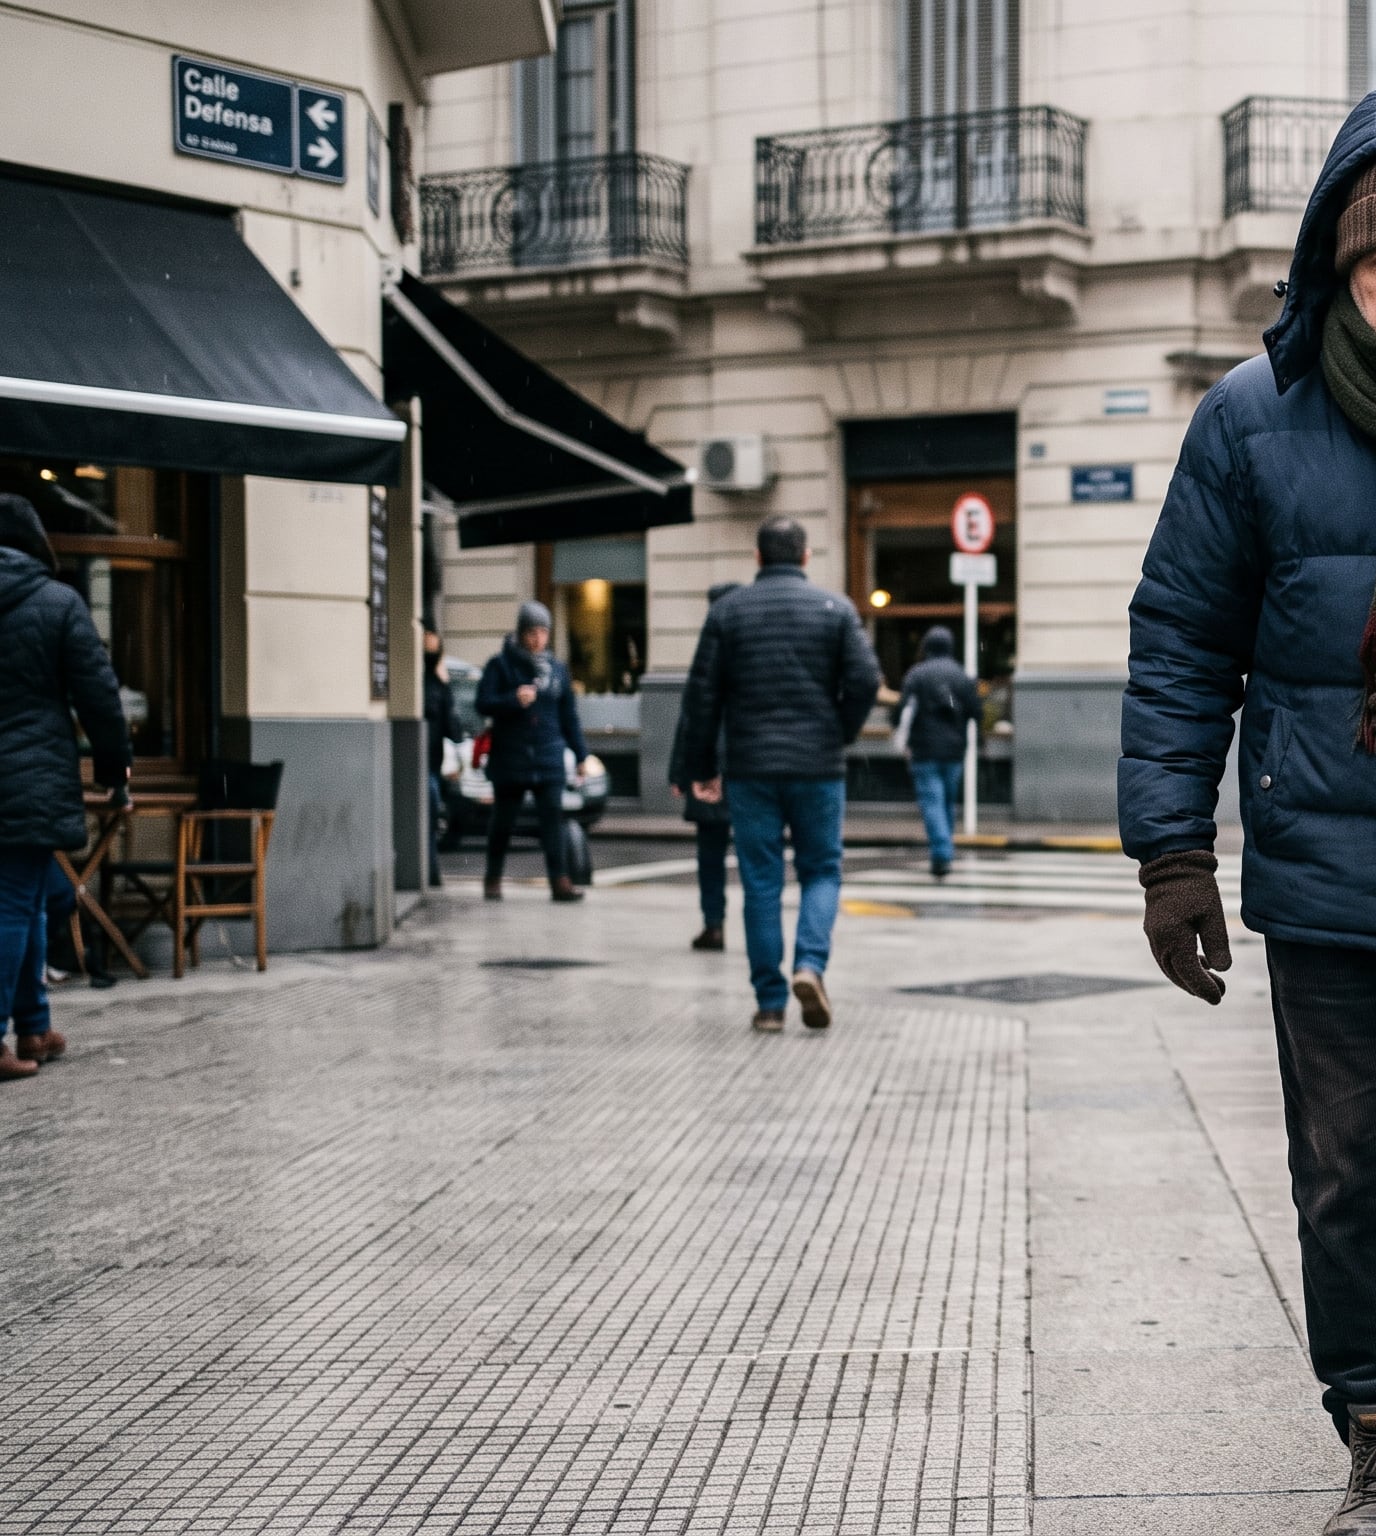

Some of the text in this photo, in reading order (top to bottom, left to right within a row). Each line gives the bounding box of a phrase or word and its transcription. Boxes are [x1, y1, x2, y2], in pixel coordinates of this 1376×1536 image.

[184, 68, 239, 100] Calle
[185, 95, 274, 136] Defensa
[965, 508, 981, 541] E
